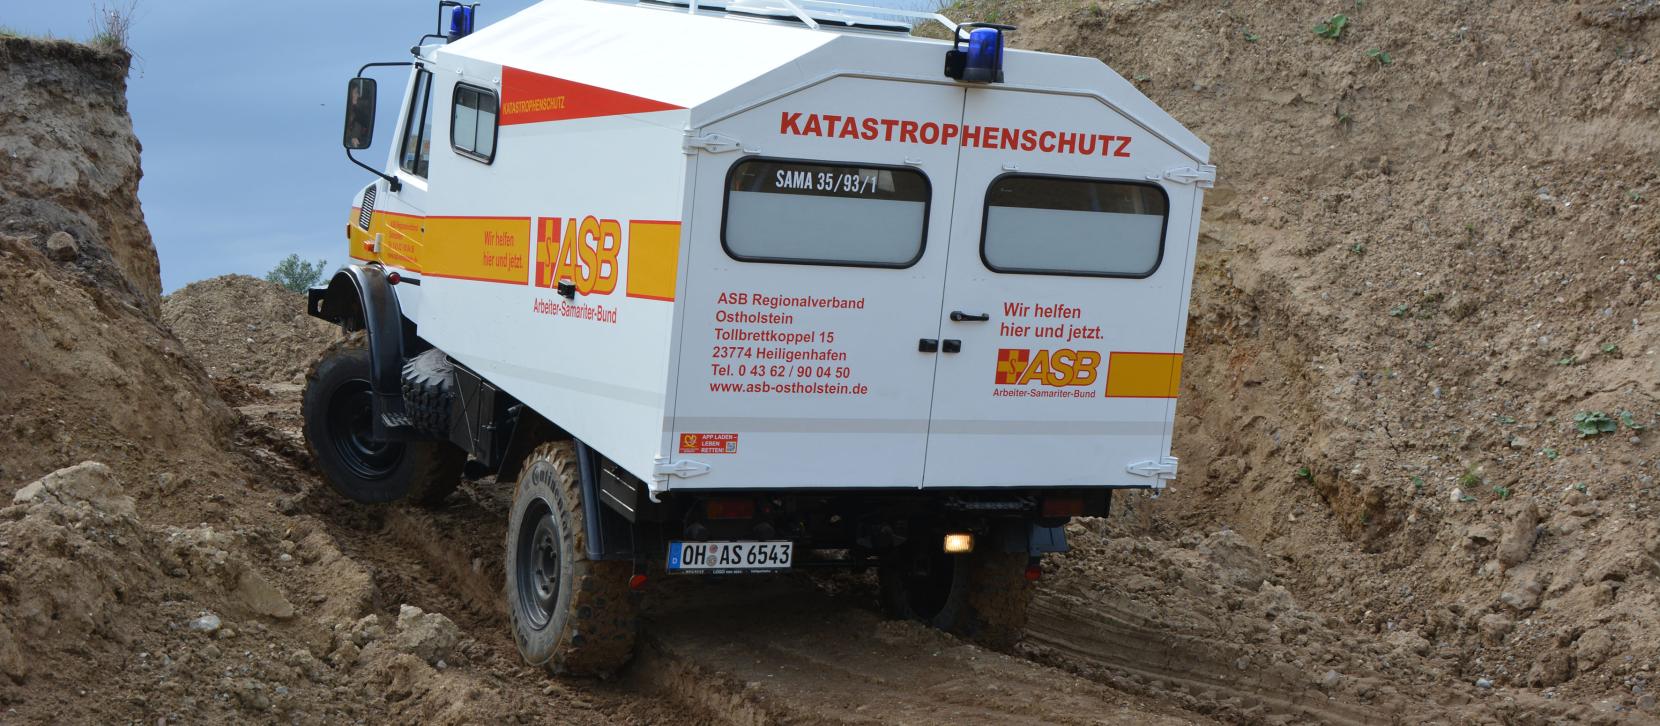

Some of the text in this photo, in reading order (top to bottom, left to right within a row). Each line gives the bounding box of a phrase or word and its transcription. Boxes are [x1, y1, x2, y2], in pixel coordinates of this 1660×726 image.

[502, 96, 566, 114] KATASTROPHENSCHUTZ
[780, 112, 1132, 158] KATASTROPHENSCHUTZ
[776, 170, 878, 194] SAMA 35/93/1
[484, 231, 514, 247] Wir helfen
[484, 252, 523, 271] hier und jetzt.
[552, 215, 622, 296] ASB
[718, 292, 864, 309] ASB Regionalverband
[534, 298, 617, 324] Arbeiter-Samariter-Bund
[716, 310, 793, 324] Ostholstein
[1004, 302, 1080, 318] Wir helfen
[714, 328, 834, 344] Tollbrettkoppel 15
[1000, 322, 1104, 342] hier und jetzt.
[712, 346, 846, 362] 23774 Heiligenhafen
[712, 364, 850, 378] Tel. 0 43 62 / 90 04 50
[1018, 348, 1101, 387] ASB
[710, 381, 868, 394] www.asb-ostholstein.de
[993, 388, 1096, 398] Arbeiter-Samariter-Bund
[682, 544, 790, 565] OH AS 6543
